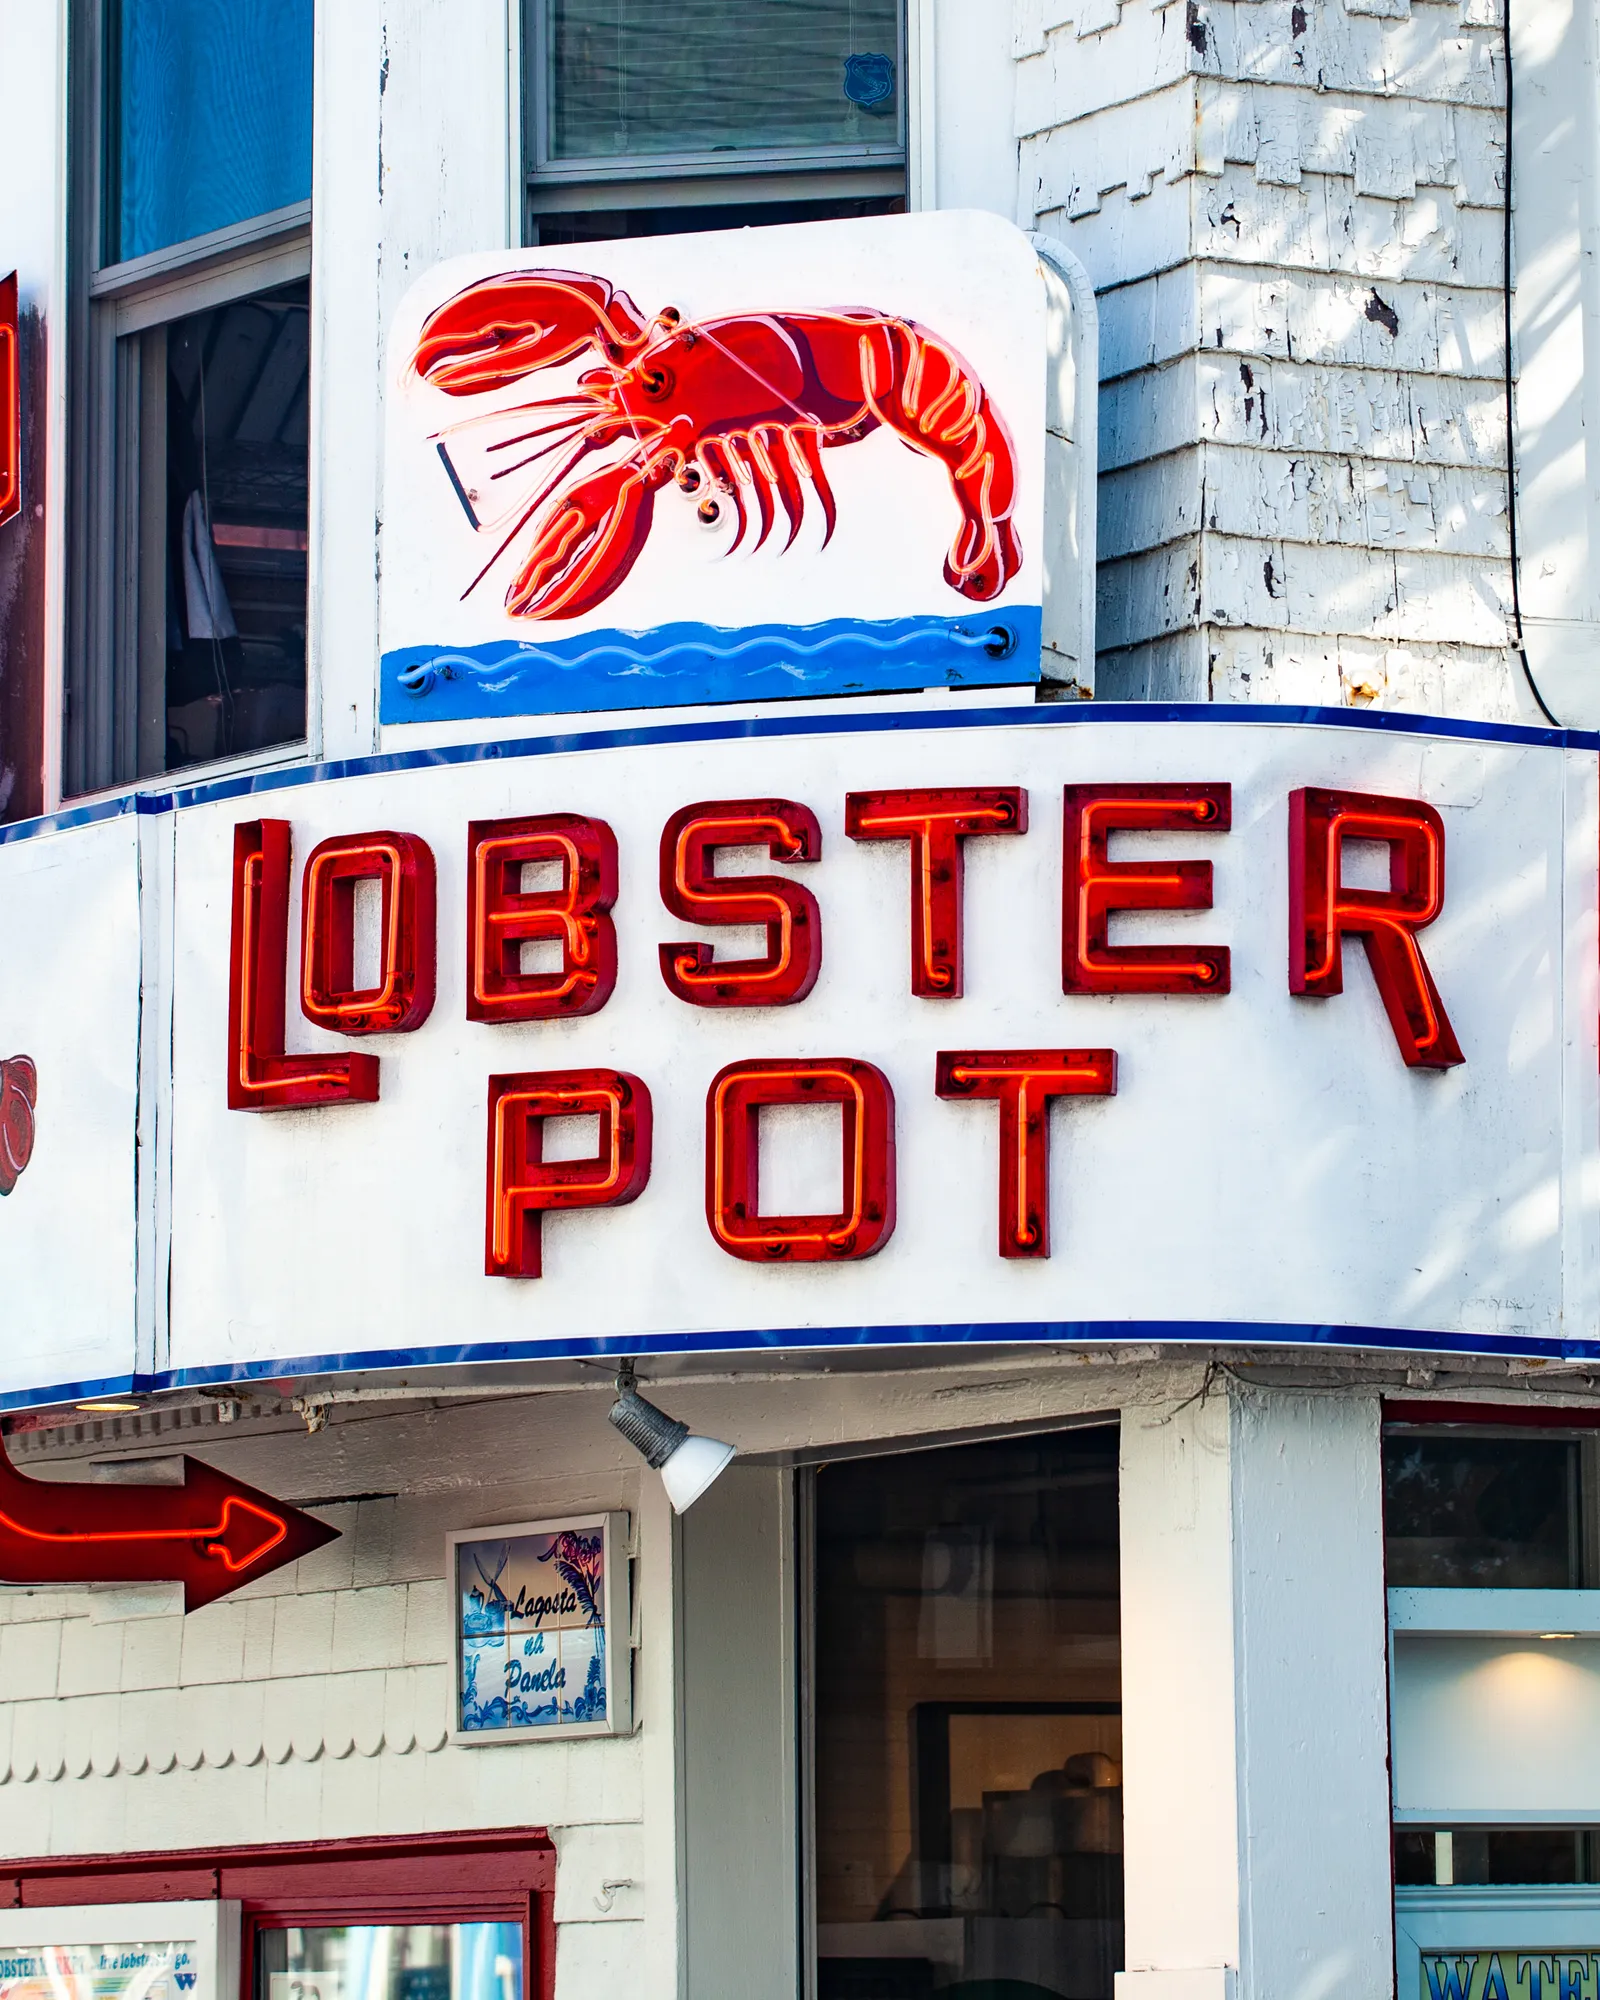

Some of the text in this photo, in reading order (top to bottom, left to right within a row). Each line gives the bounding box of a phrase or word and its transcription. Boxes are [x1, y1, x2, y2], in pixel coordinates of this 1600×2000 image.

[228, 783, 1466, 1113] LOBSTER
[486, 1048, 1117, 1279] POT
[510, 1584, 577, 1628] Lagosta
[523, 1632, 545, 1656] na
[504, 1657, 566, 1698] Panela
[1421, 1953, 1600, 2000] WATE
